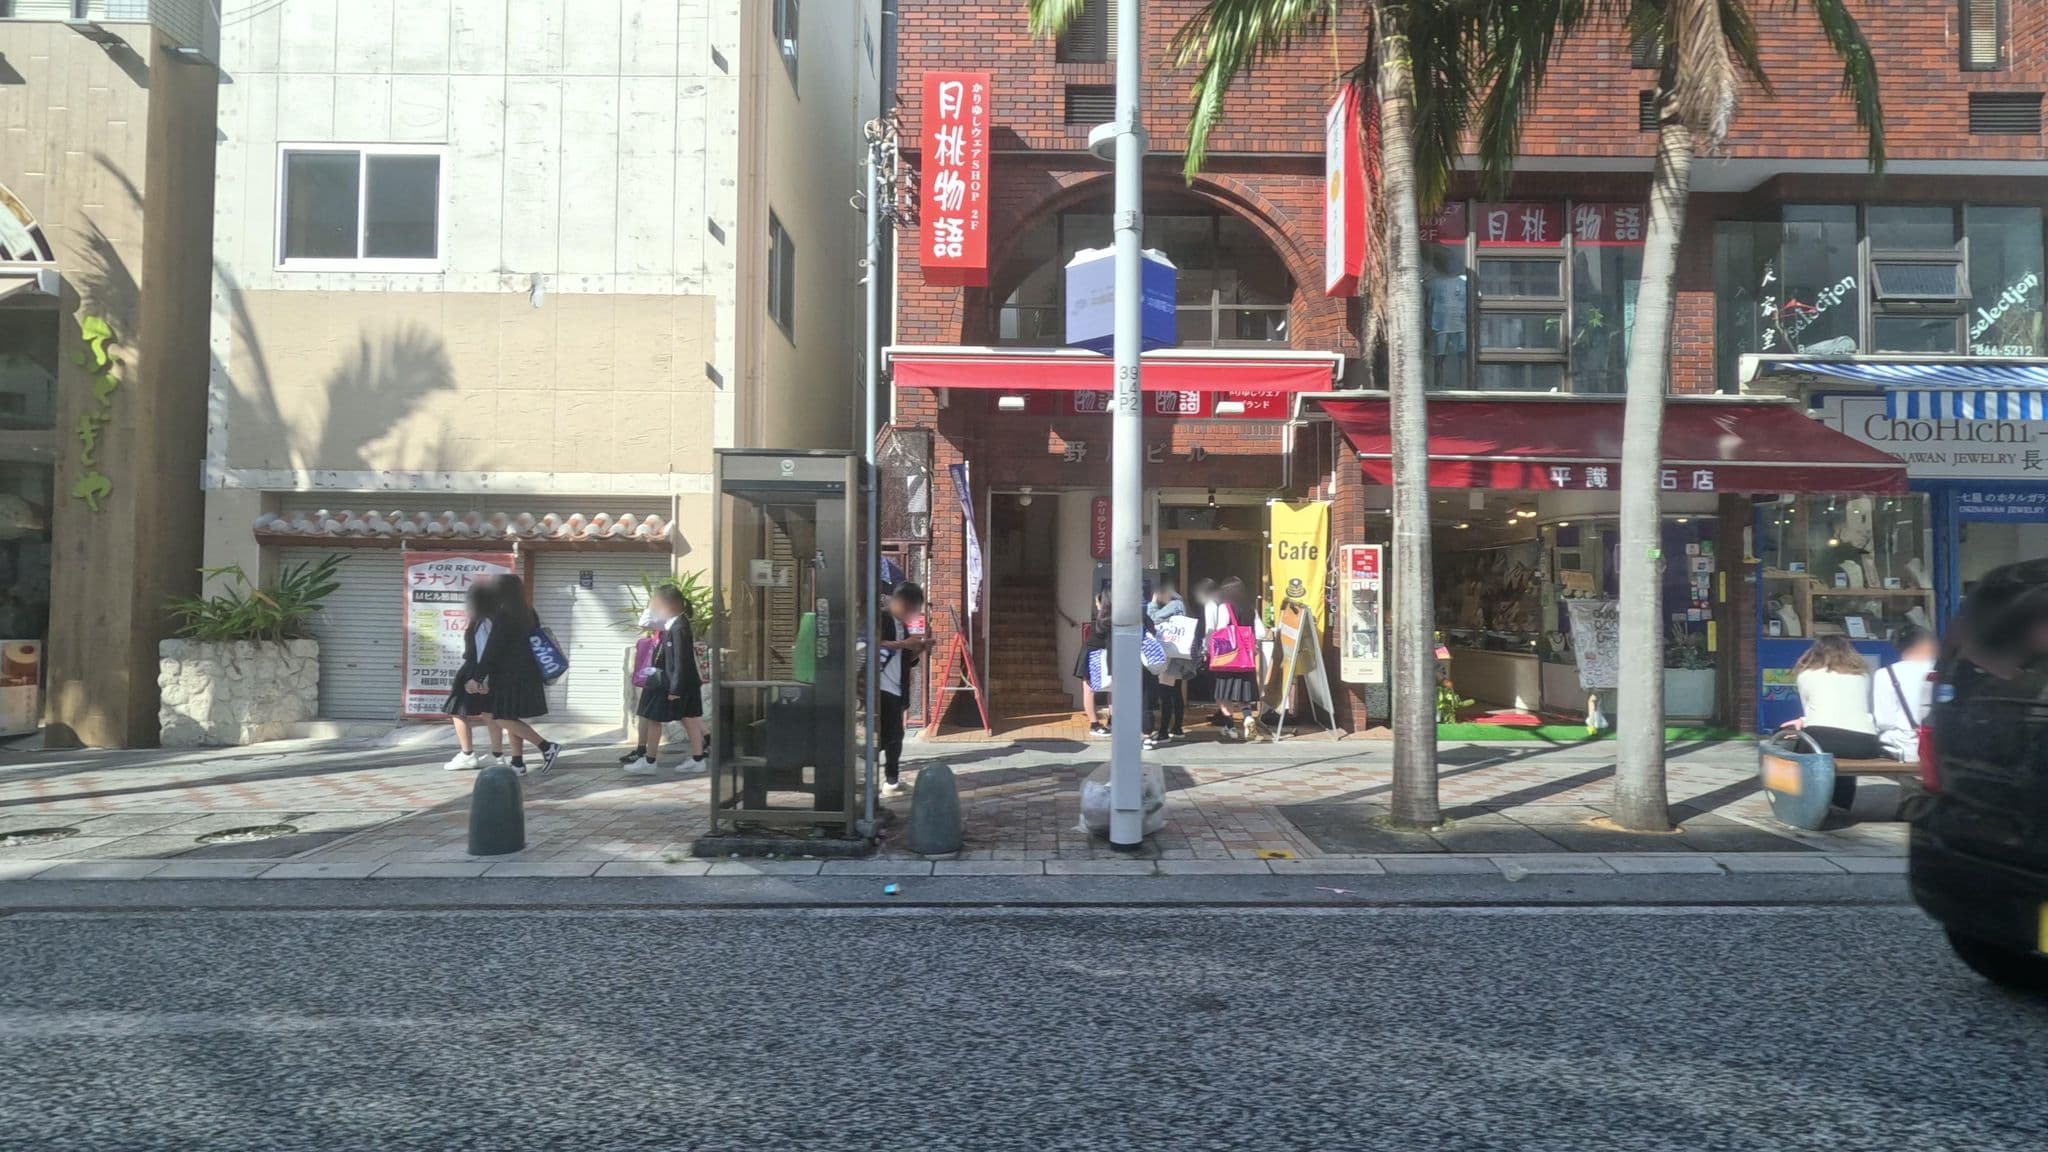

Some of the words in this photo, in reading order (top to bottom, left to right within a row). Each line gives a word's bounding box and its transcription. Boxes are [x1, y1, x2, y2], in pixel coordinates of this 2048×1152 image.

[933, 81, 966, 258] 月桃物語
[970, 209, 980, 230] 2F
[1488, 208, 1641, 243] 月桃物語
[1970, 274, 2038, 340] selection
[1976, 344, 2033, 355] 866-5212
[1120, 366, 1138, 380] 39
[1120, 396, 1138, 411] P2
[1243, 400, 1270, 409] ランド
[1063, 441, 1208, 464] 野ビル
[1952, 453, 2017, 467] JEWELRY
[2022, 450, 2048, 471] 長
[1550, 466, 1714, 491] 平識石店
[1278, 540, 1319, 560] Cafe
[428, 564, 452, 572] FOR
[456, 564, 487, 572] RENT
[412, 572, 480, 587] テナント
